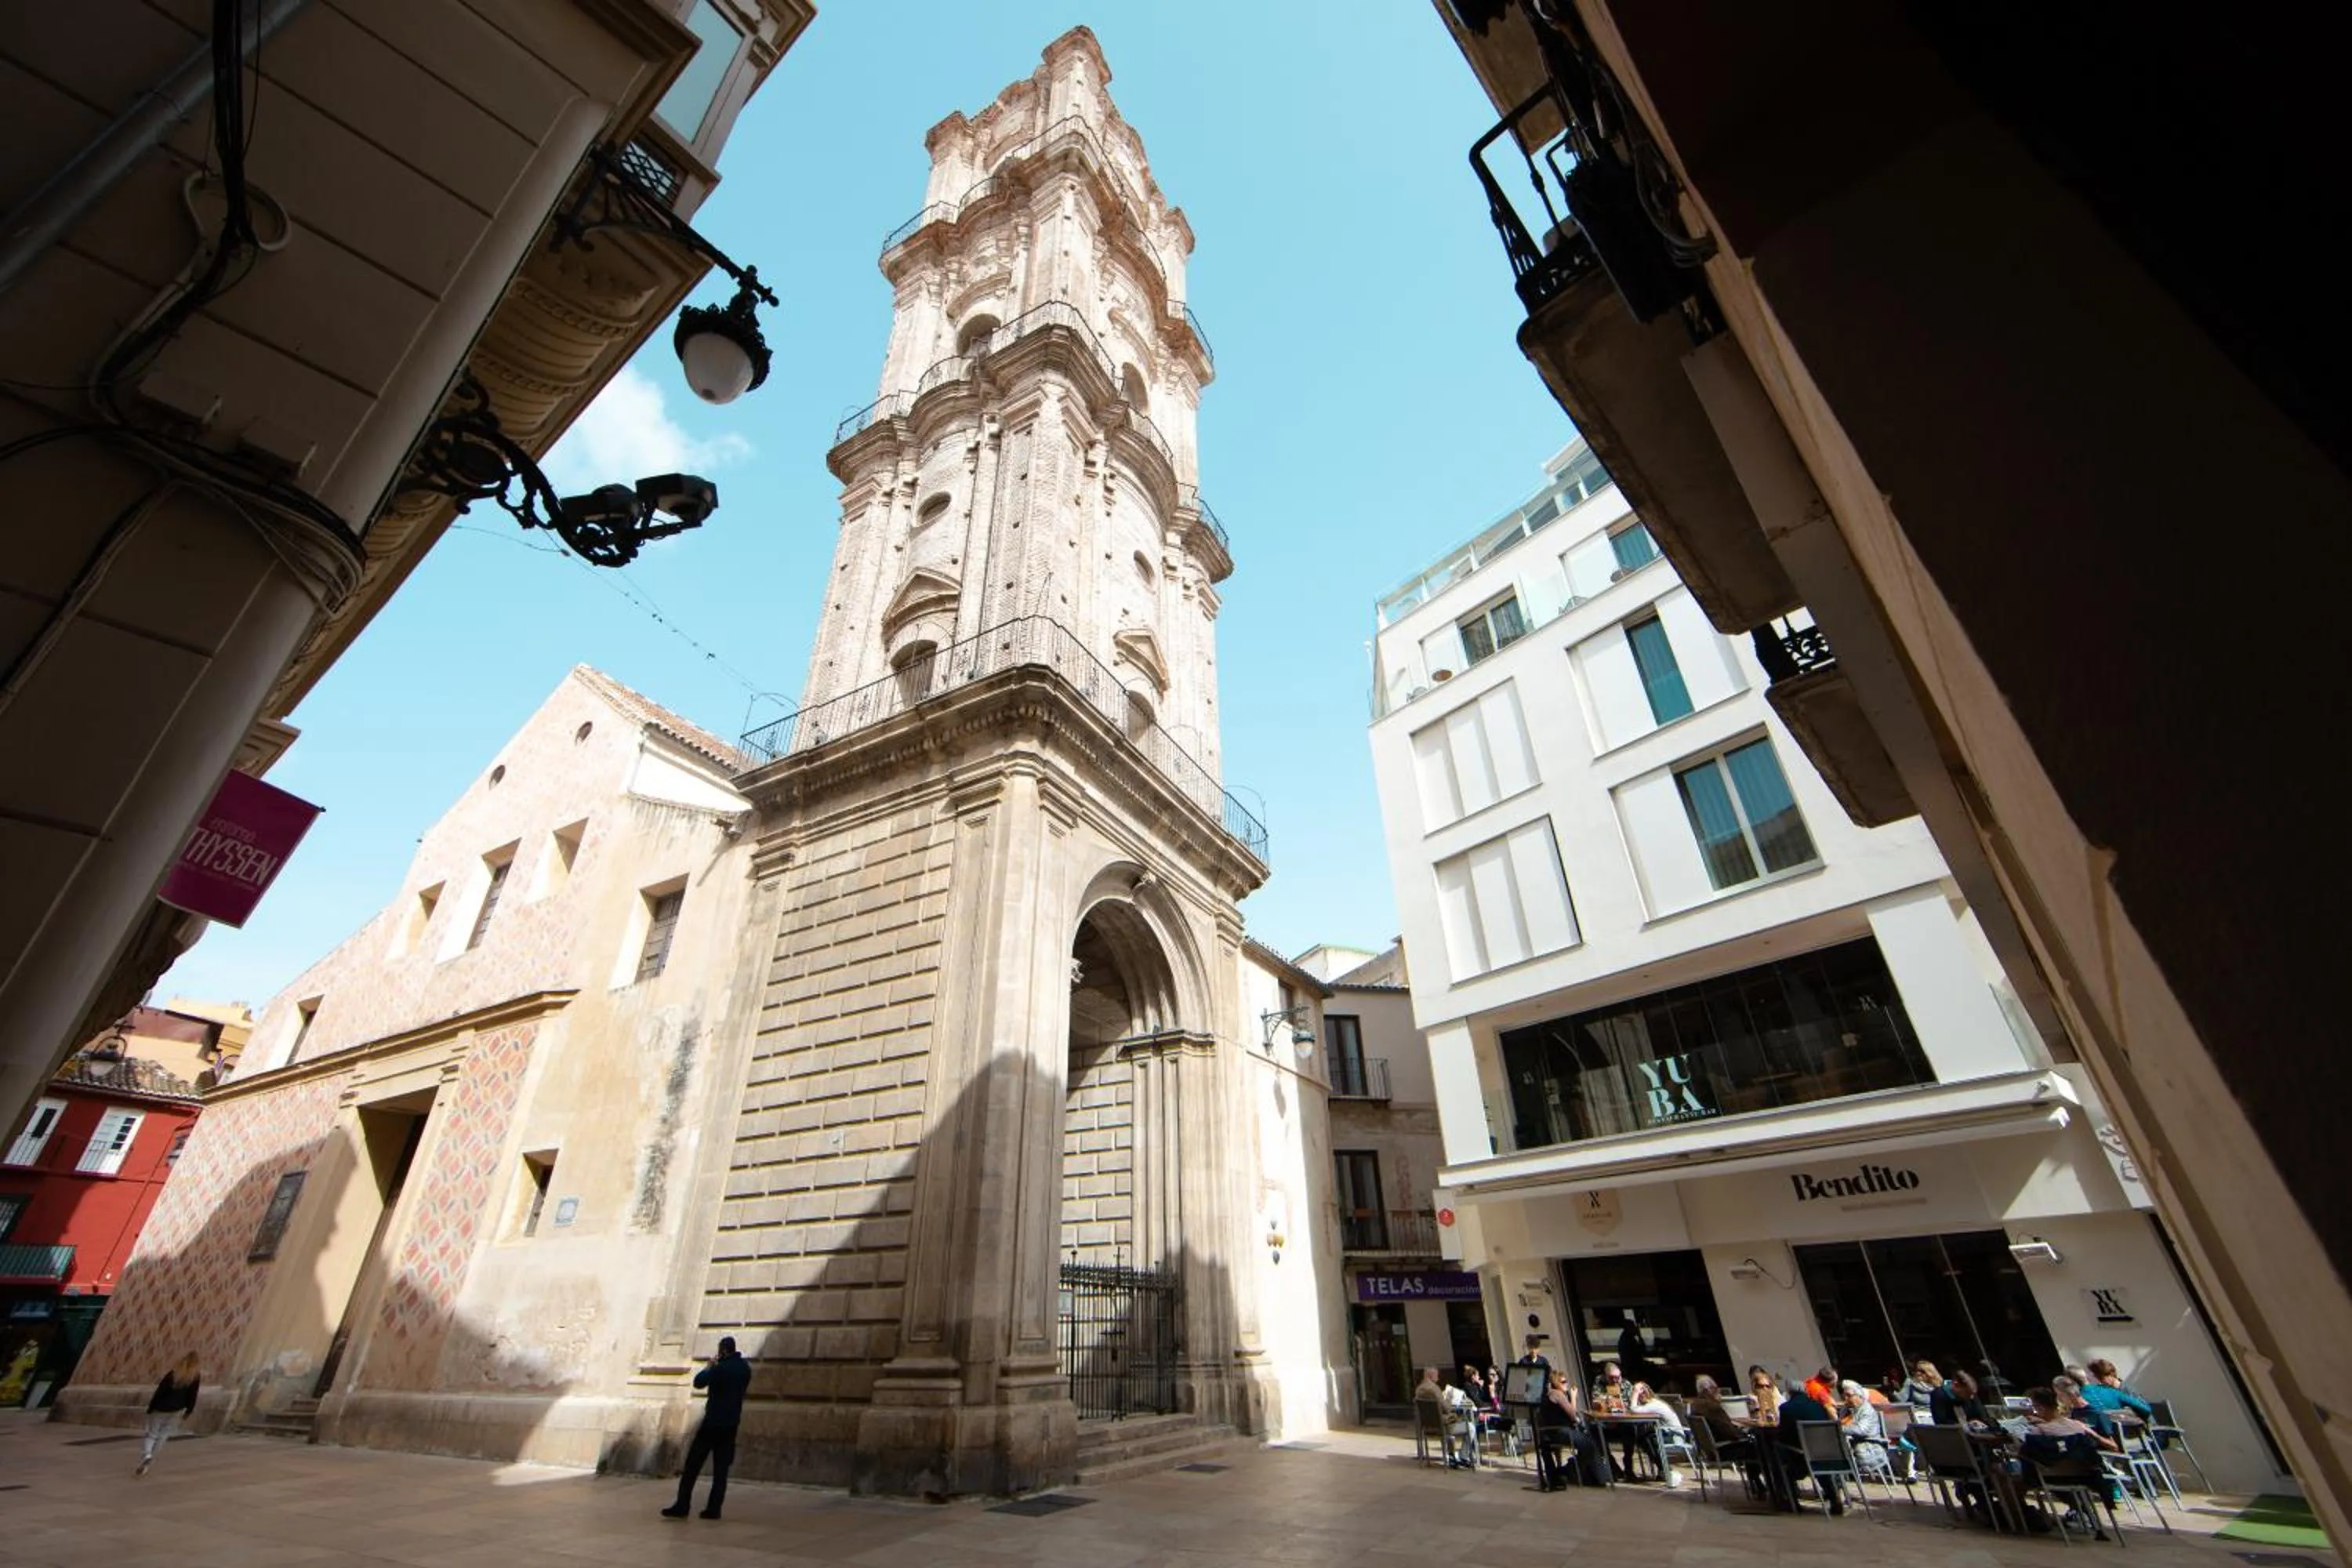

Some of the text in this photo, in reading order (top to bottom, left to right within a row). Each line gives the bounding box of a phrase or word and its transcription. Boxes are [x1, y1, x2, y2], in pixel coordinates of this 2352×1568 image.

[179, 826, 278, 886] THYSSEN
[1791, 1164, 1920, 1202] Bendito
[1367, 1276, 1425, 1295] TELAS
